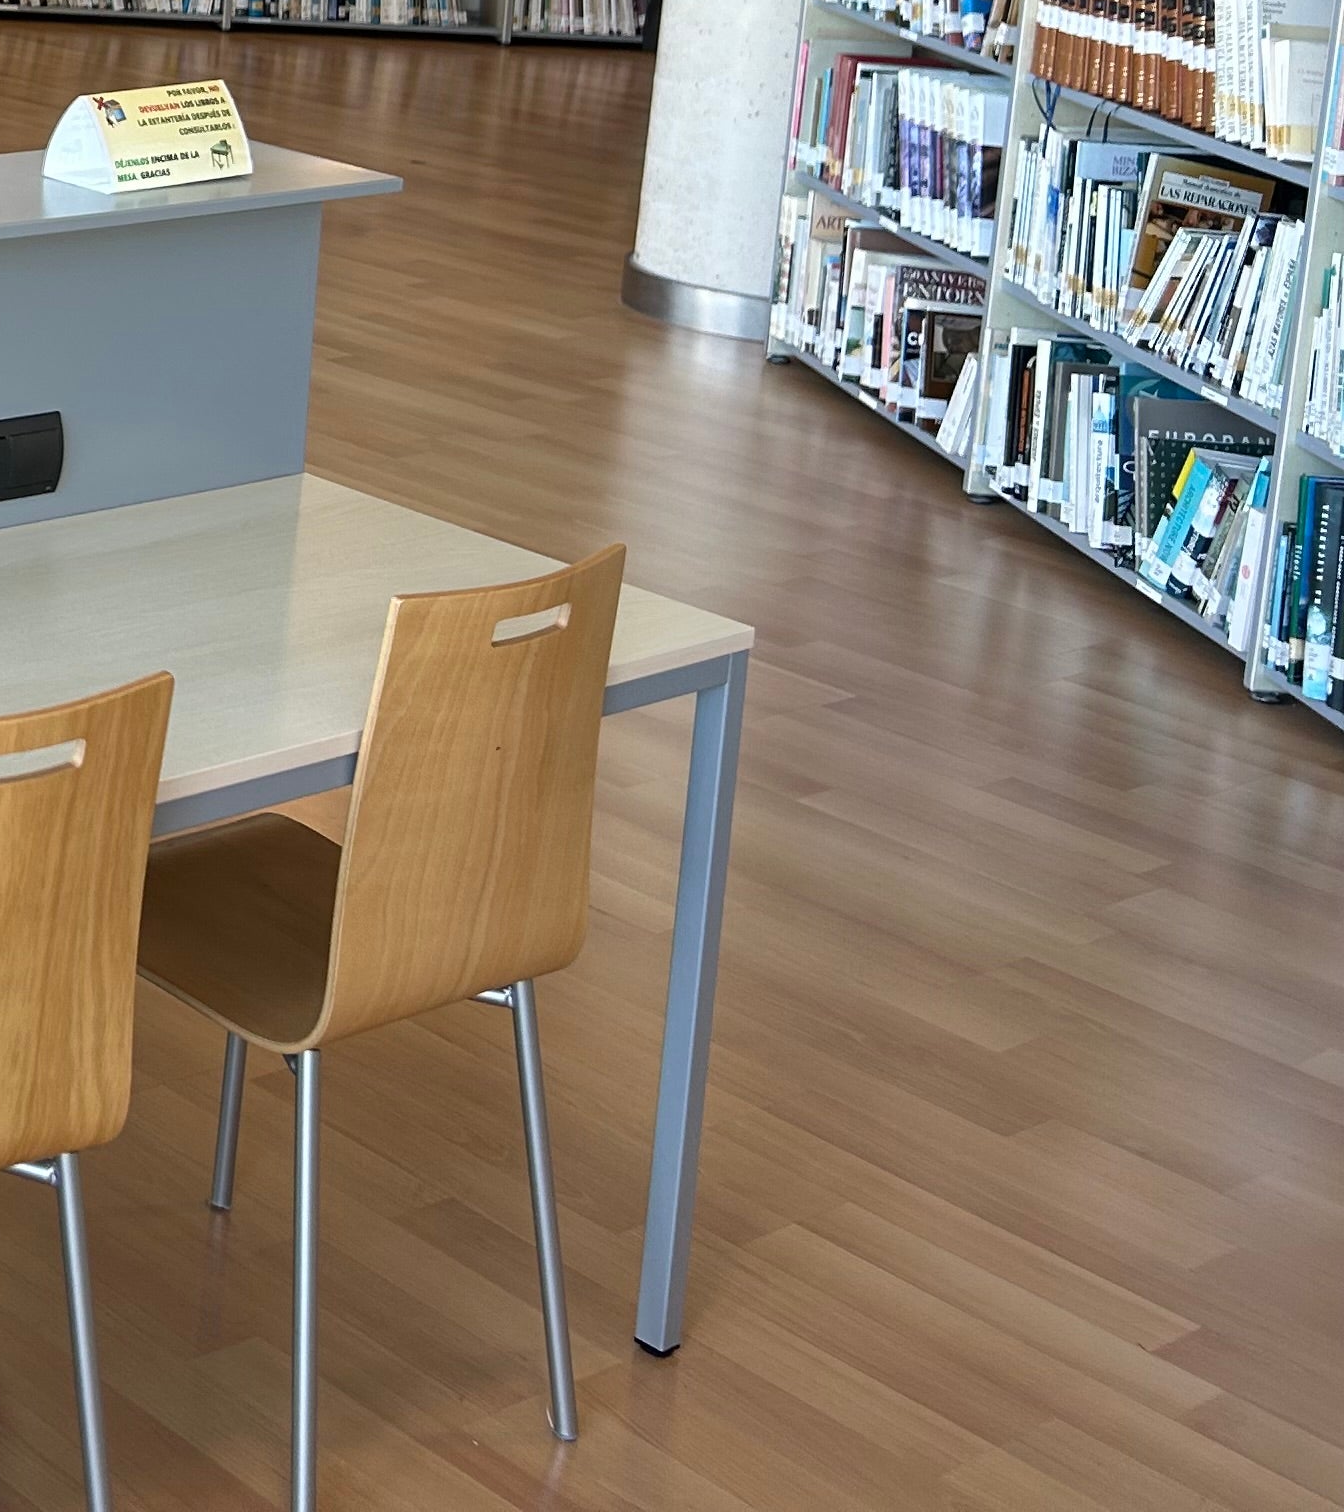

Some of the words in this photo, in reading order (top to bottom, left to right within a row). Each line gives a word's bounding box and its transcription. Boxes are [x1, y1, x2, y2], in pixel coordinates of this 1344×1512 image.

[208, 85, 220, 93] NO
[138, 103, 181, 114] DEVUELVAN
[182, 99, 194, 108] LOS
[195, 97, 219, 107] LIBROS
[137, 119, 147, 127] LA
[148, 114, 190, 126] ESTANTERÍA
[191, 110, 221, 120] DESPUÉS
[222, 108, 231, 117] DE
[151, 153, 178, 163] ENCIMA
[180, 151, 189, 160] DE
[190, 150, 200, 158] LA
[140, 170, 170, 179] GRACIAS
[1160, 185, 1180, 199] LAS
[1183, 190, 1257, 215] REPARACIONES
